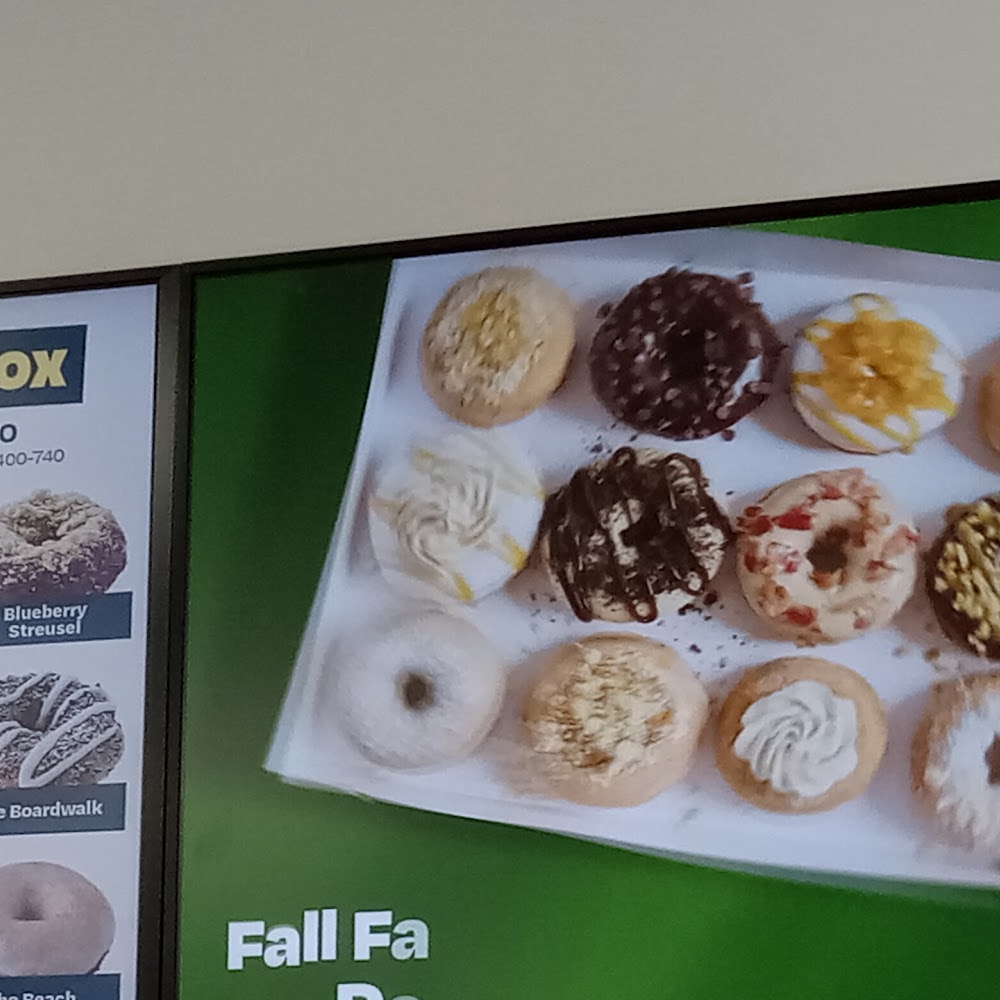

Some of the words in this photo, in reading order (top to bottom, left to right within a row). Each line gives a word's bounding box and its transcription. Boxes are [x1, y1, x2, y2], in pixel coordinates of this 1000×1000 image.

[3, 603, 88, 624] Blueberry
[8, 620, 82, 639] Streusel
[10, 801, 103, 820] Boardwalk
[227, 908, 338, 971] Fall
[354, 910, 429, 961] Fa
